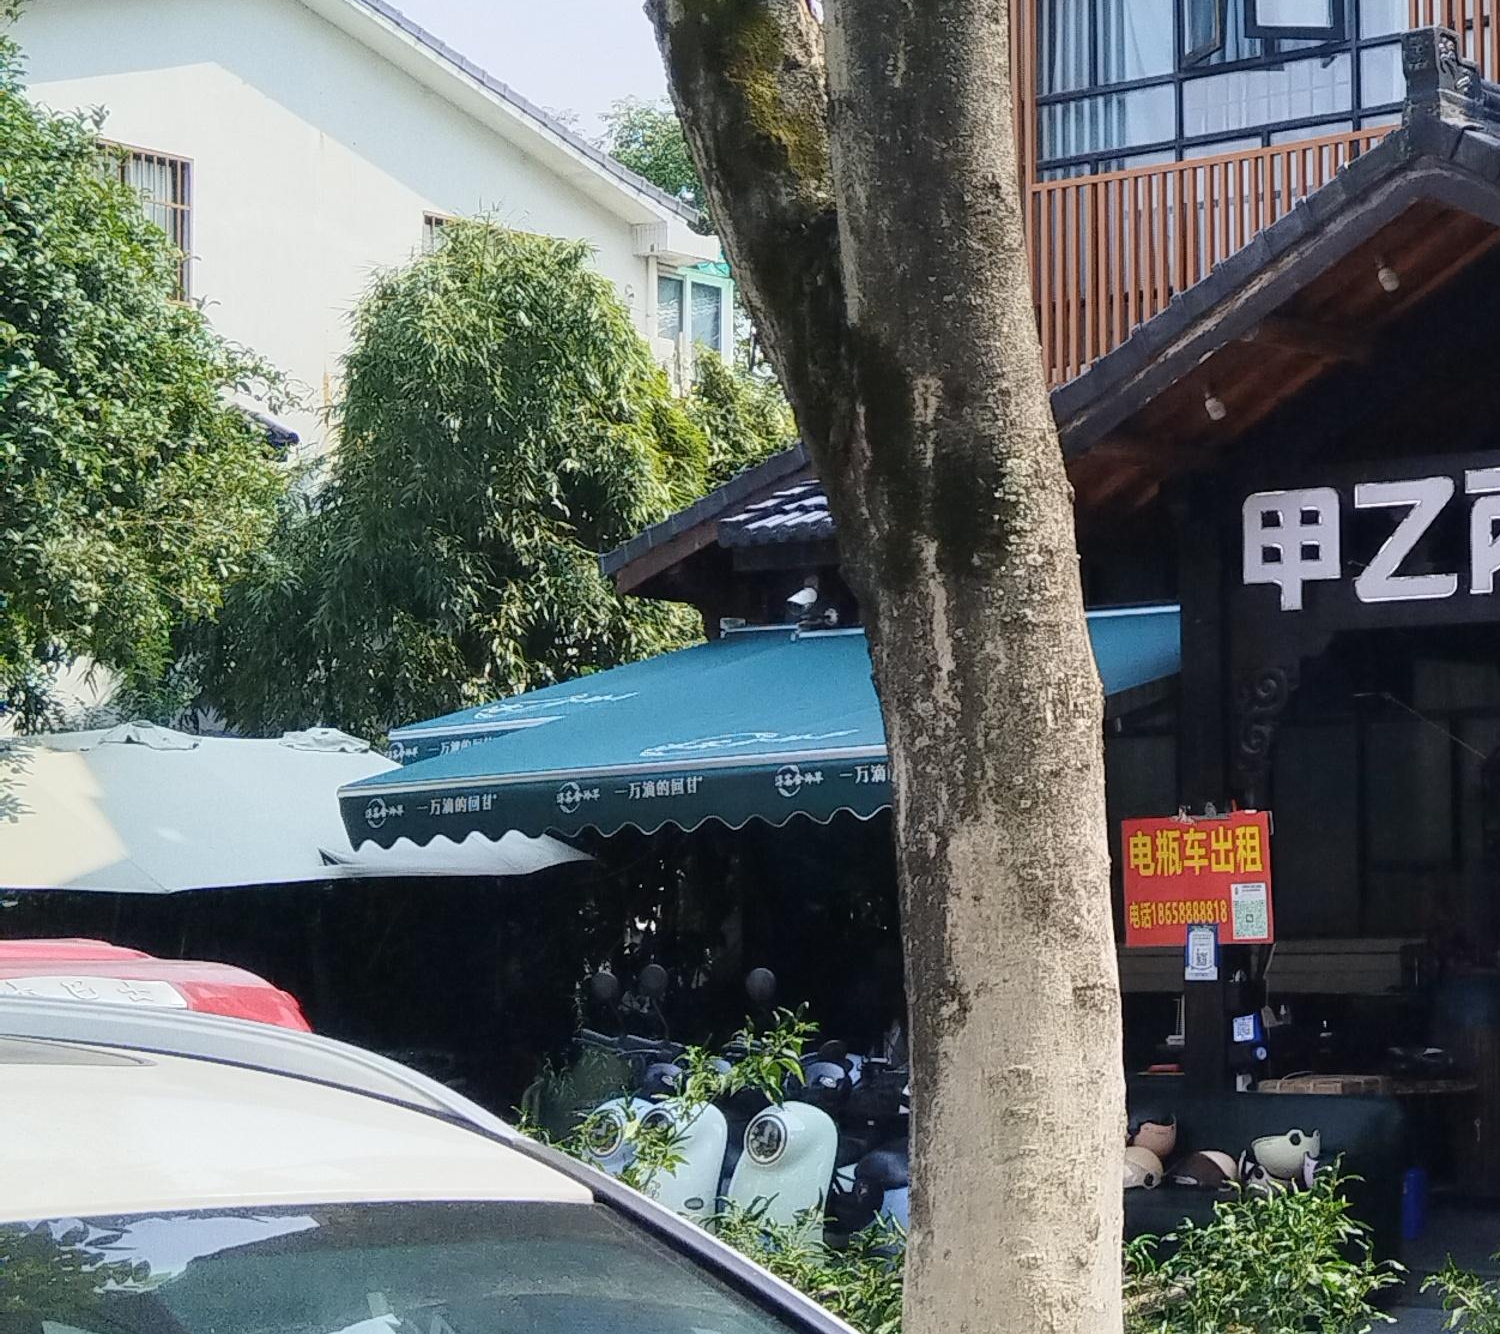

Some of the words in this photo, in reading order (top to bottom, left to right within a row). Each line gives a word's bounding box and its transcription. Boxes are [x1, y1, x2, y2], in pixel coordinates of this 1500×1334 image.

[1129, 825, 1263, 876] 电瓶车出租
